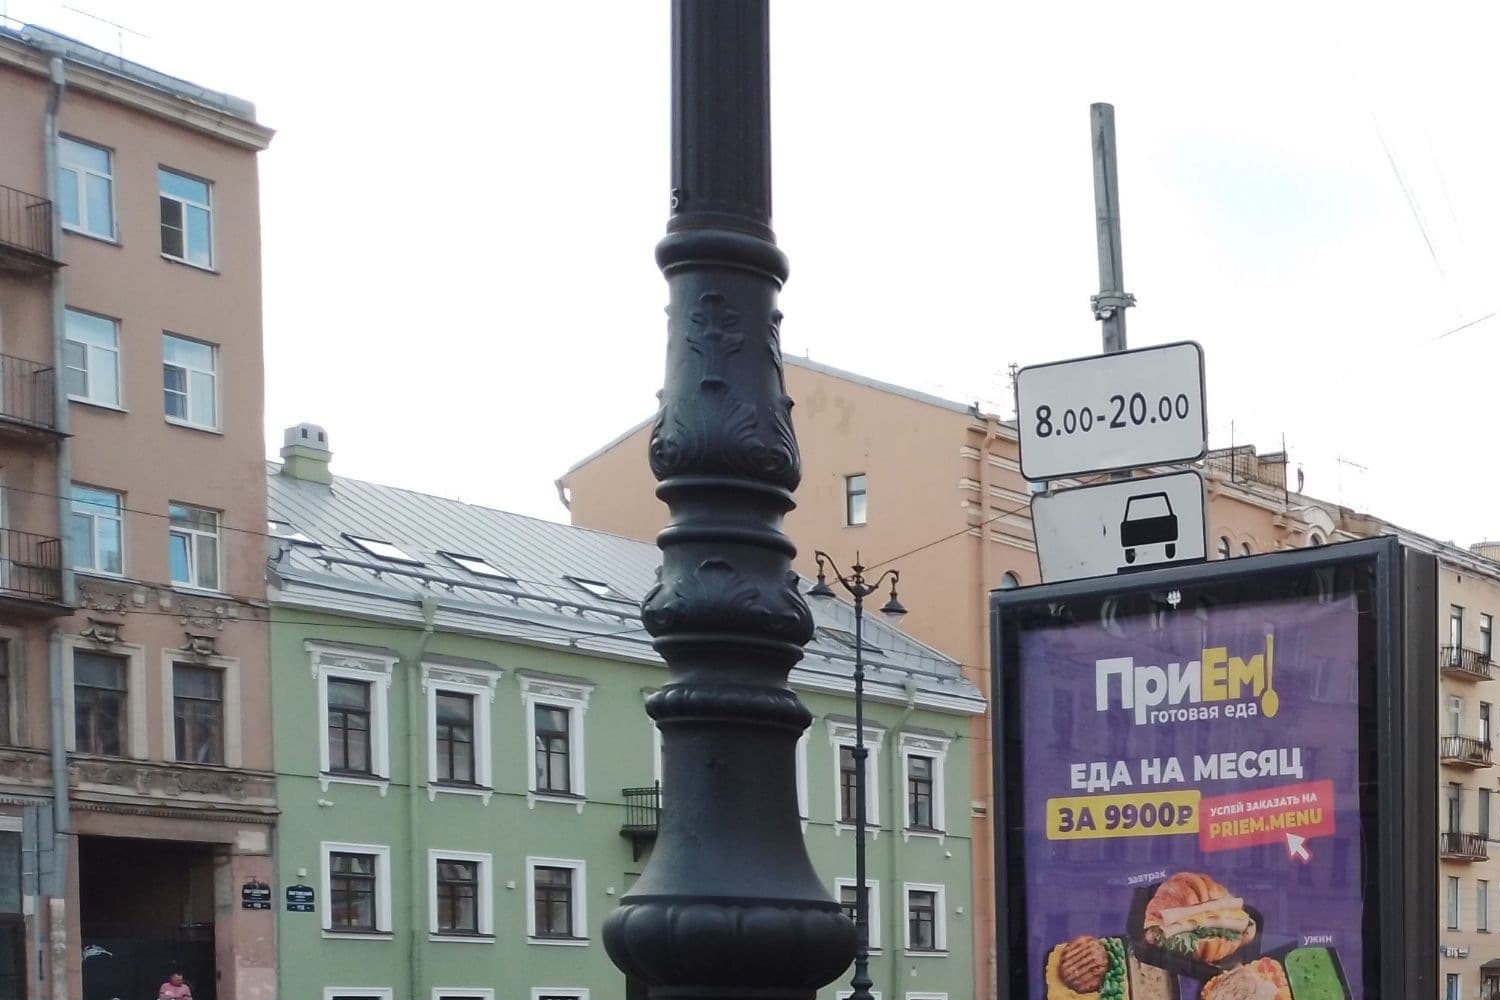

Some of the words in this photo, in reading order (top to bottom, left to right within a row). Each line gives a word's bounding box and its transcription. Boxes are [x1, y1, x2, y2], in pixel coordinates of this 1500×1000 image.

[1035, 392, 1189, 438] 8.00-20.00
[1150, 705, 1219, 724] готовая
[1225, 702, 1258, 719] еда
[1070, 760, 1133, 793] ЕДА
[1141, 757, 1185, 785] НА
[1193, 747, 1304, 781] МЕСЯЦ
[1210, 801, 1244, 817] УСПЕЙ
[1246, 795, 1300, 812] ЗАКАЗАТЬ
[1302, 792, 1318, 804] НА
[1058, 806, 1097, 833] ЗА
[1209, 807, 1322, 839] PRIEM.MENU
